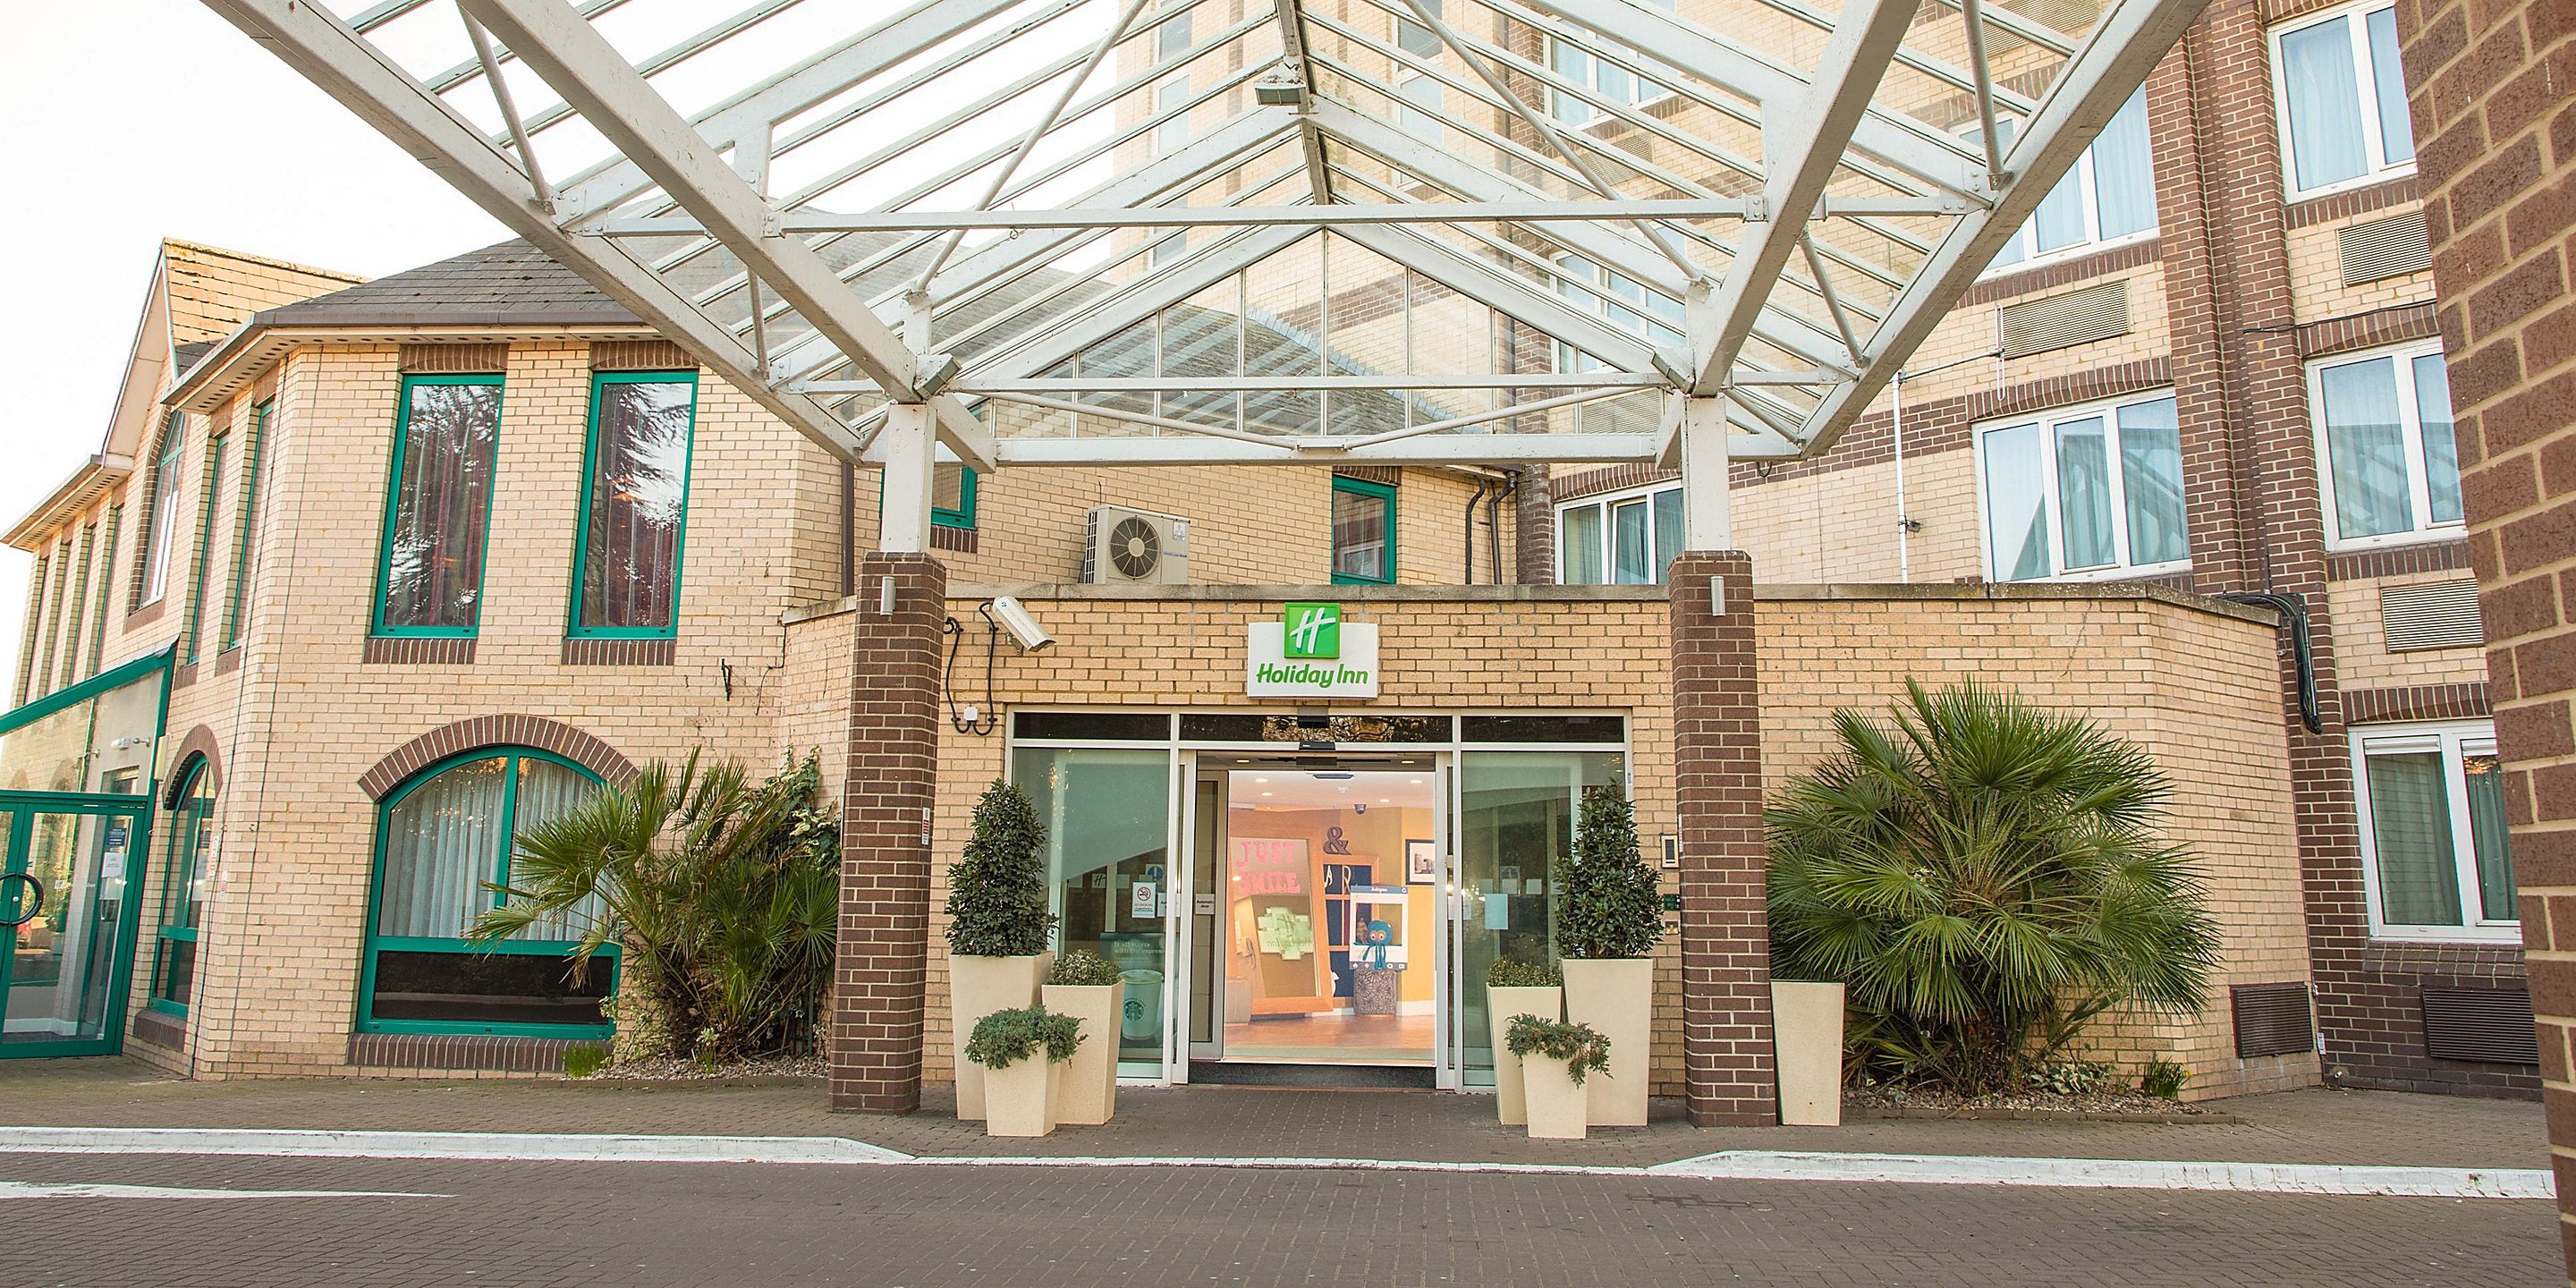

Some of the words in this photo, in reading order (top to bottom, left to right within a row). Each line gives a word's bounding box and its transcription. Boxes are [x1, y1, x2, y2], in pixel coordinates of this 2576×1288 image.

[1289, 607, 1336, 654] H
[1256, 663, 1335, 689] Holiday
[1336, 664, 1368, 684] Inn
[1236, 841, 1295, 868] JUST
[1323, 826, 1352, 856] &
[1238, 872, 1301, 894] SMILE
